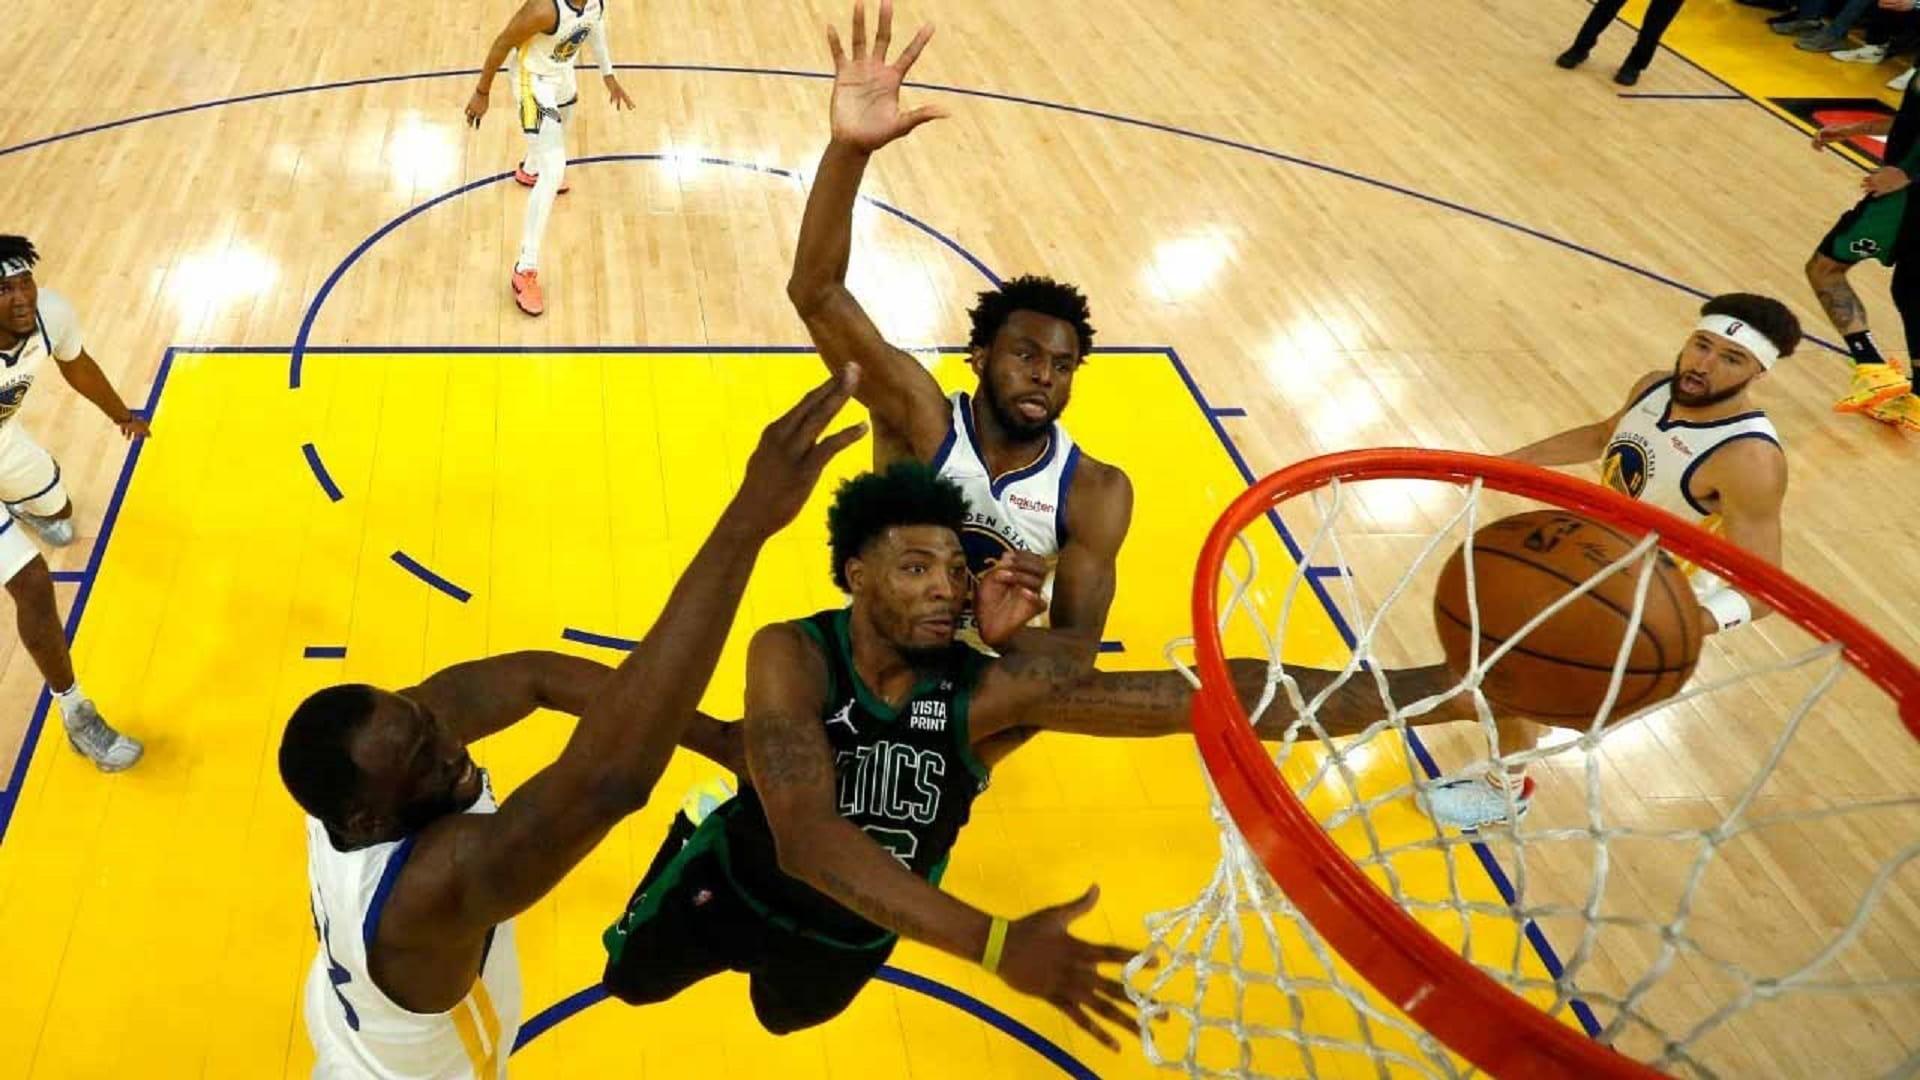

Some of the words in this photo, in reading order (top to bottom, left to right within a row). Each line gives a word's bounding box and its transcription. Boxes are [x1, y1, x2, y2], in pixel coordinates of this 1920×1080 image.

[1009, 494, 1055, 512] Rakuten
[962, 512, 997, 527] DEN
[911, 700, 947, 719] VISTA
[910, 716, 947, 731] PRINT
